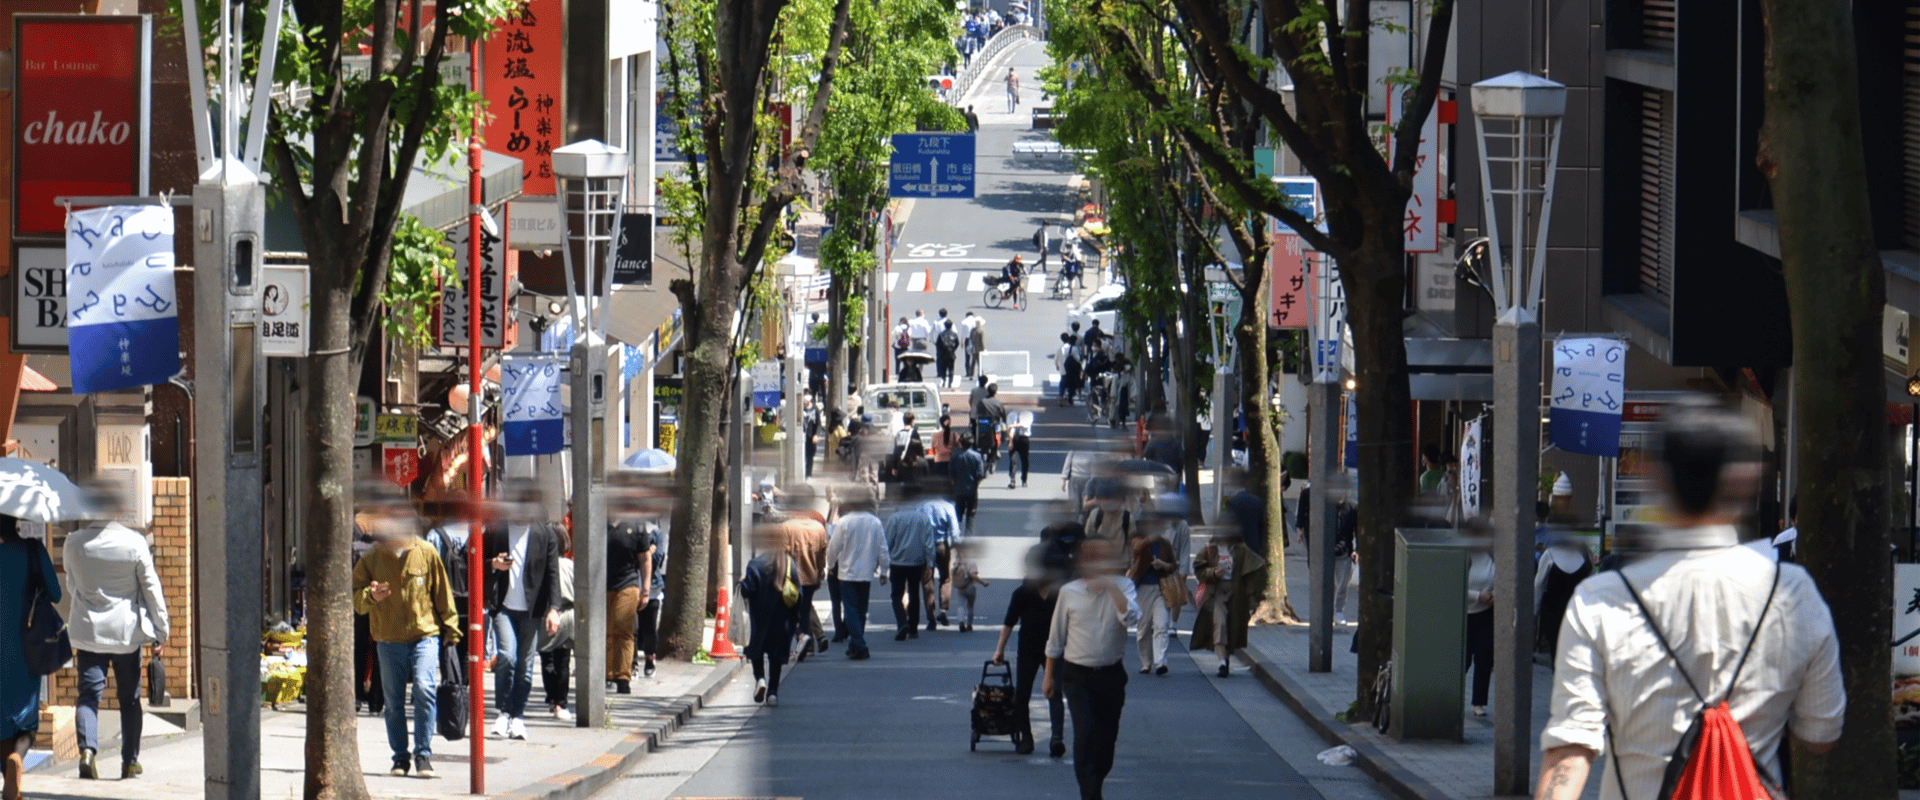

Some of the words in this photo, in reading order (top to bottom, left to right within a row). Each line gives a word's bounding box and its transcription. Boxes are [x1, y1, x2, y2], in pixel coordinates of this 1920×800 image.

[23, 110, 131, 145] chako
[536, 93, 554, 179] 神楽坂店
[918, 136, 951, 148] 九段下
[106, 430, 132, 464] HAIR
